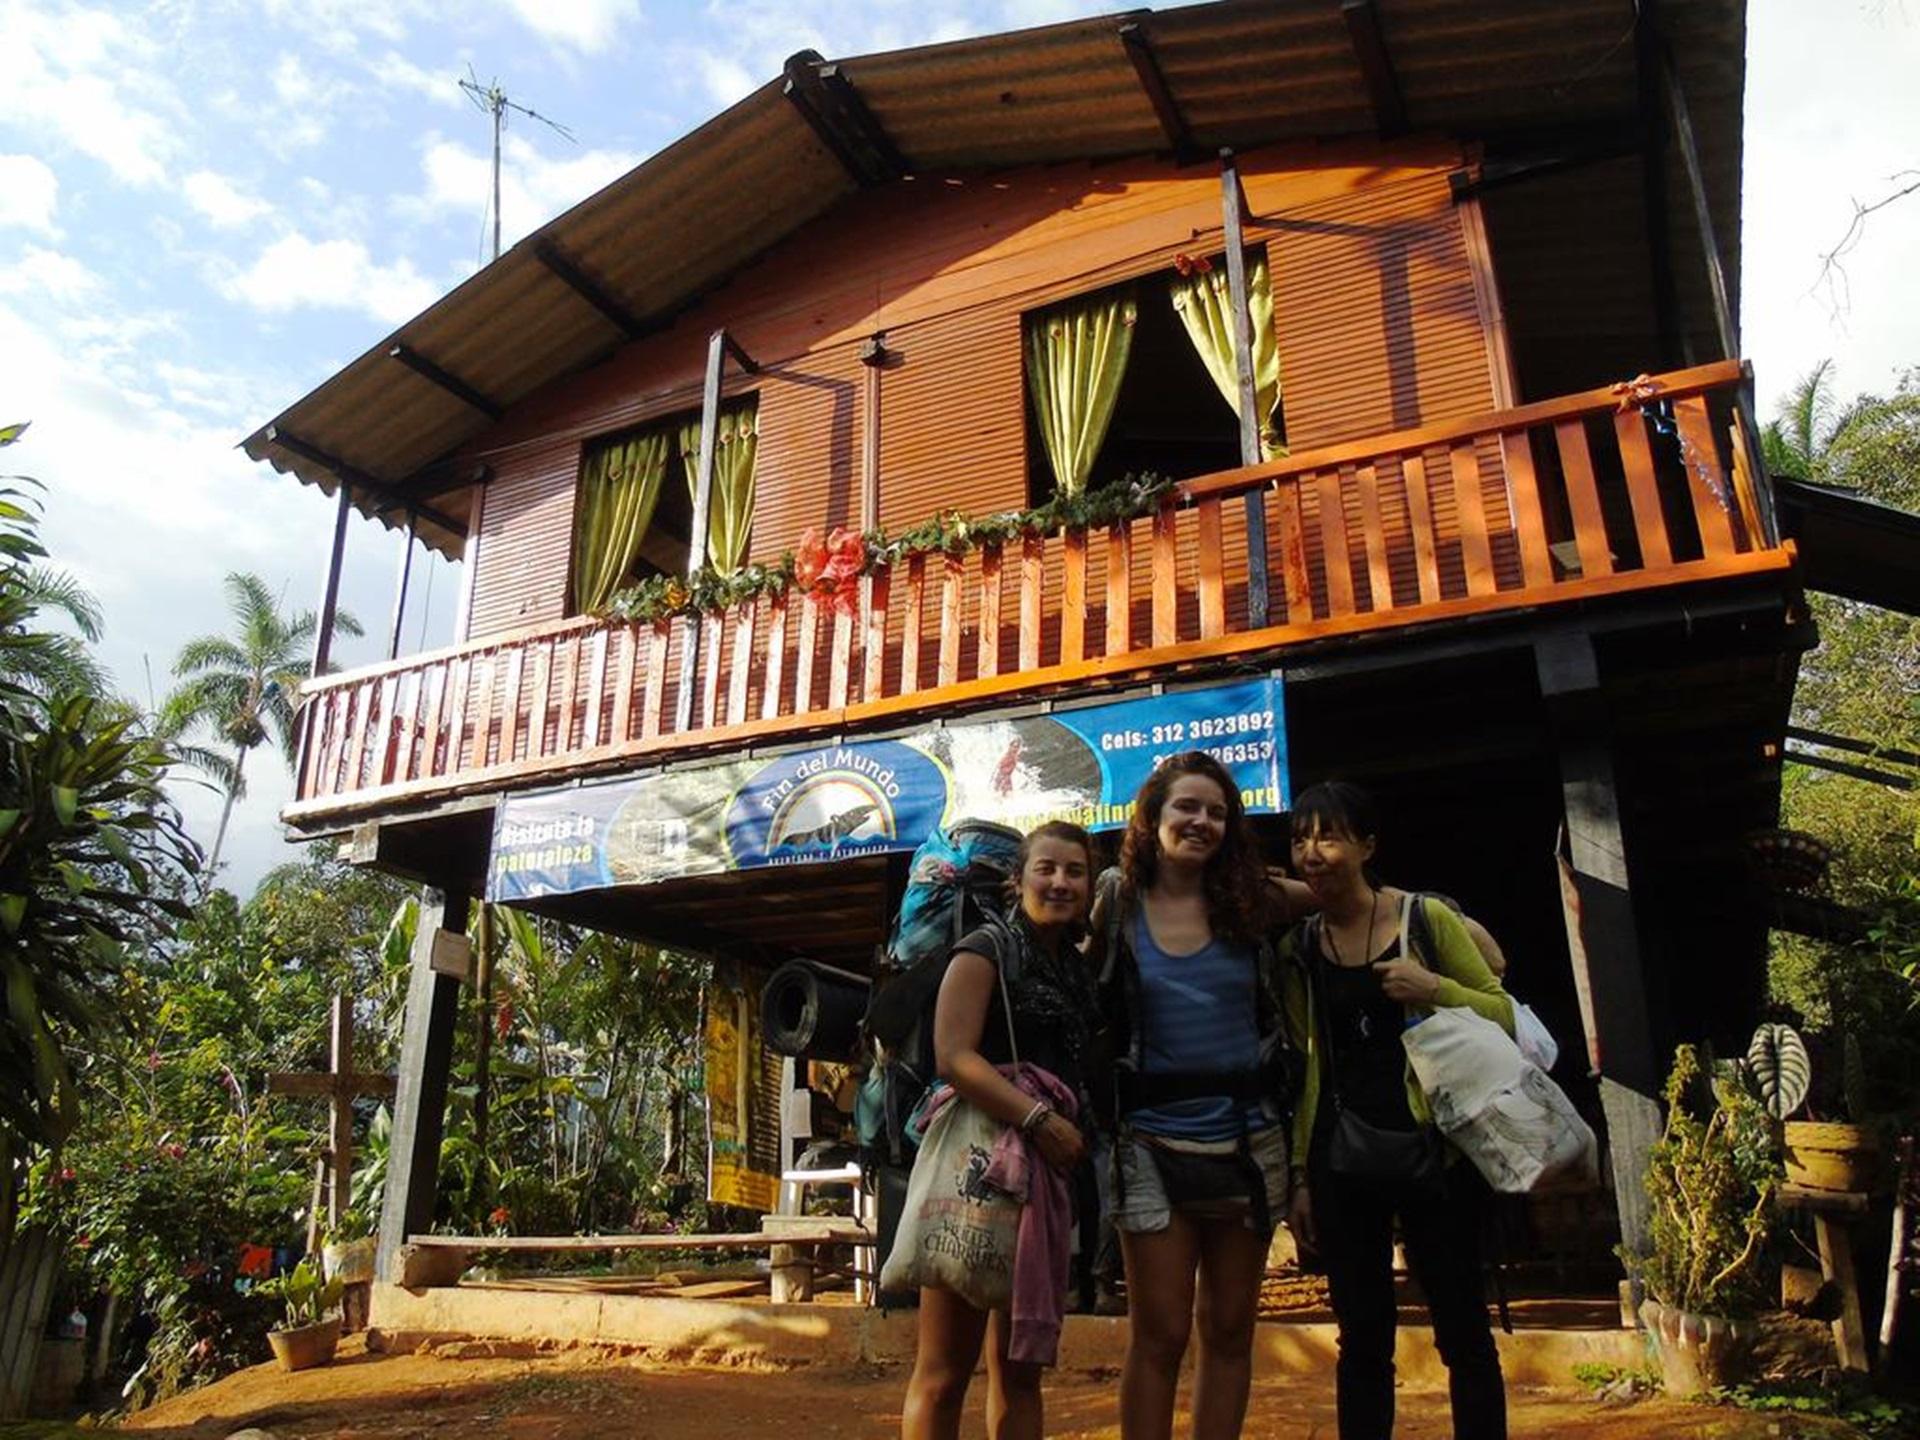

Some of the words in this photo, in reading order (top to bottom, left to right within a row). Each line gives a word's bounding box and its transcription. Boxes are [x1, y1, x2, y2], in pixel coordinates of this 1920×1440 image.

[1101, 731, 1147, 751] Cels:
[1152, 723, 1184, 745] 312
[1189, 710, 1275, 739] 3623892
[762, 778, 794, 812] Fin
[796, 753, 828, 779] del
[833, 748, 900, 798] Mundo
[577, 815, 595, 837] la
[496, 843, 593, 874] naturaleza
